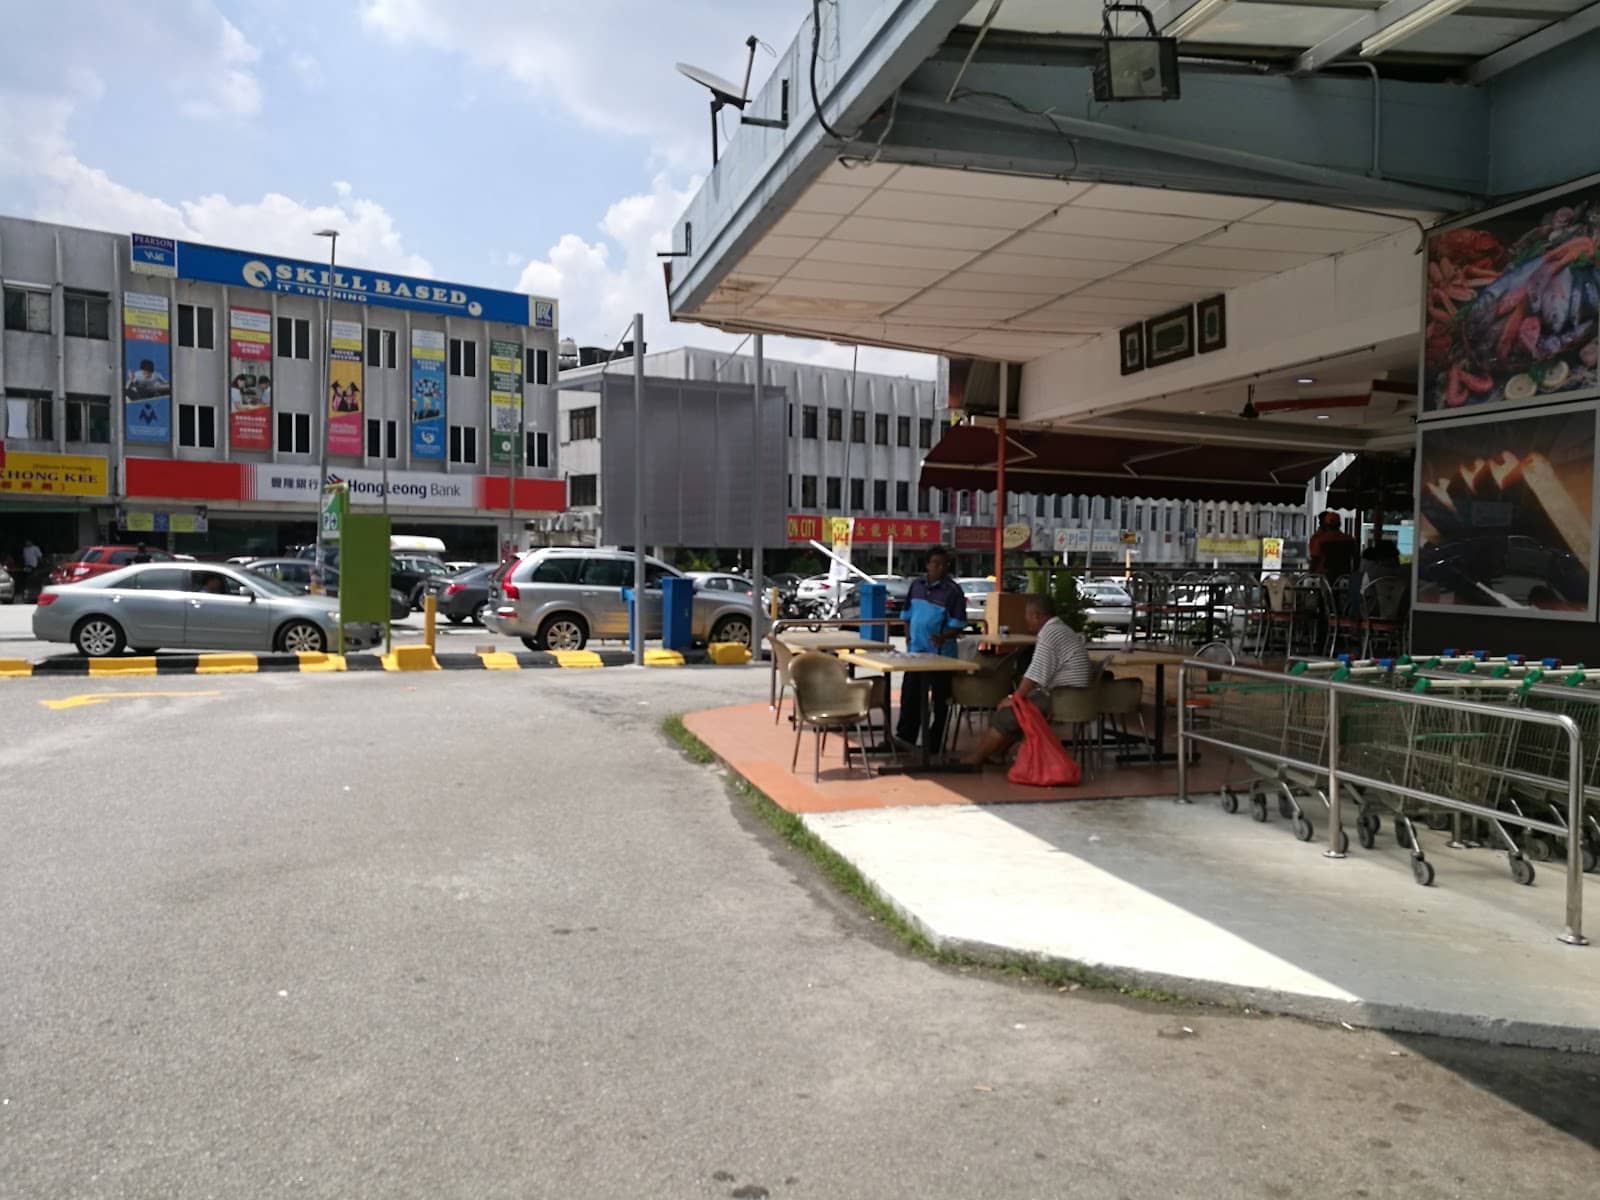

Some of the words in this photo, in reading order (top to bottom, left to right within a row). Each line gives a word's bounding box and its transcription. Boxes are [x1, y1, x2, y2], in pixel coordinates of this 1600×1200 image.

[134, 235, 173, 249] PEARSON
[275, 264, 368, 290] SKILL
[375, 279, 467, 305] BASED
[277, 283, 291, 292] IT
[297, 286, 368, 303] TRAINING
[65, 473, 97, 484] KEE
[430, 482, 461, 496] Bank
